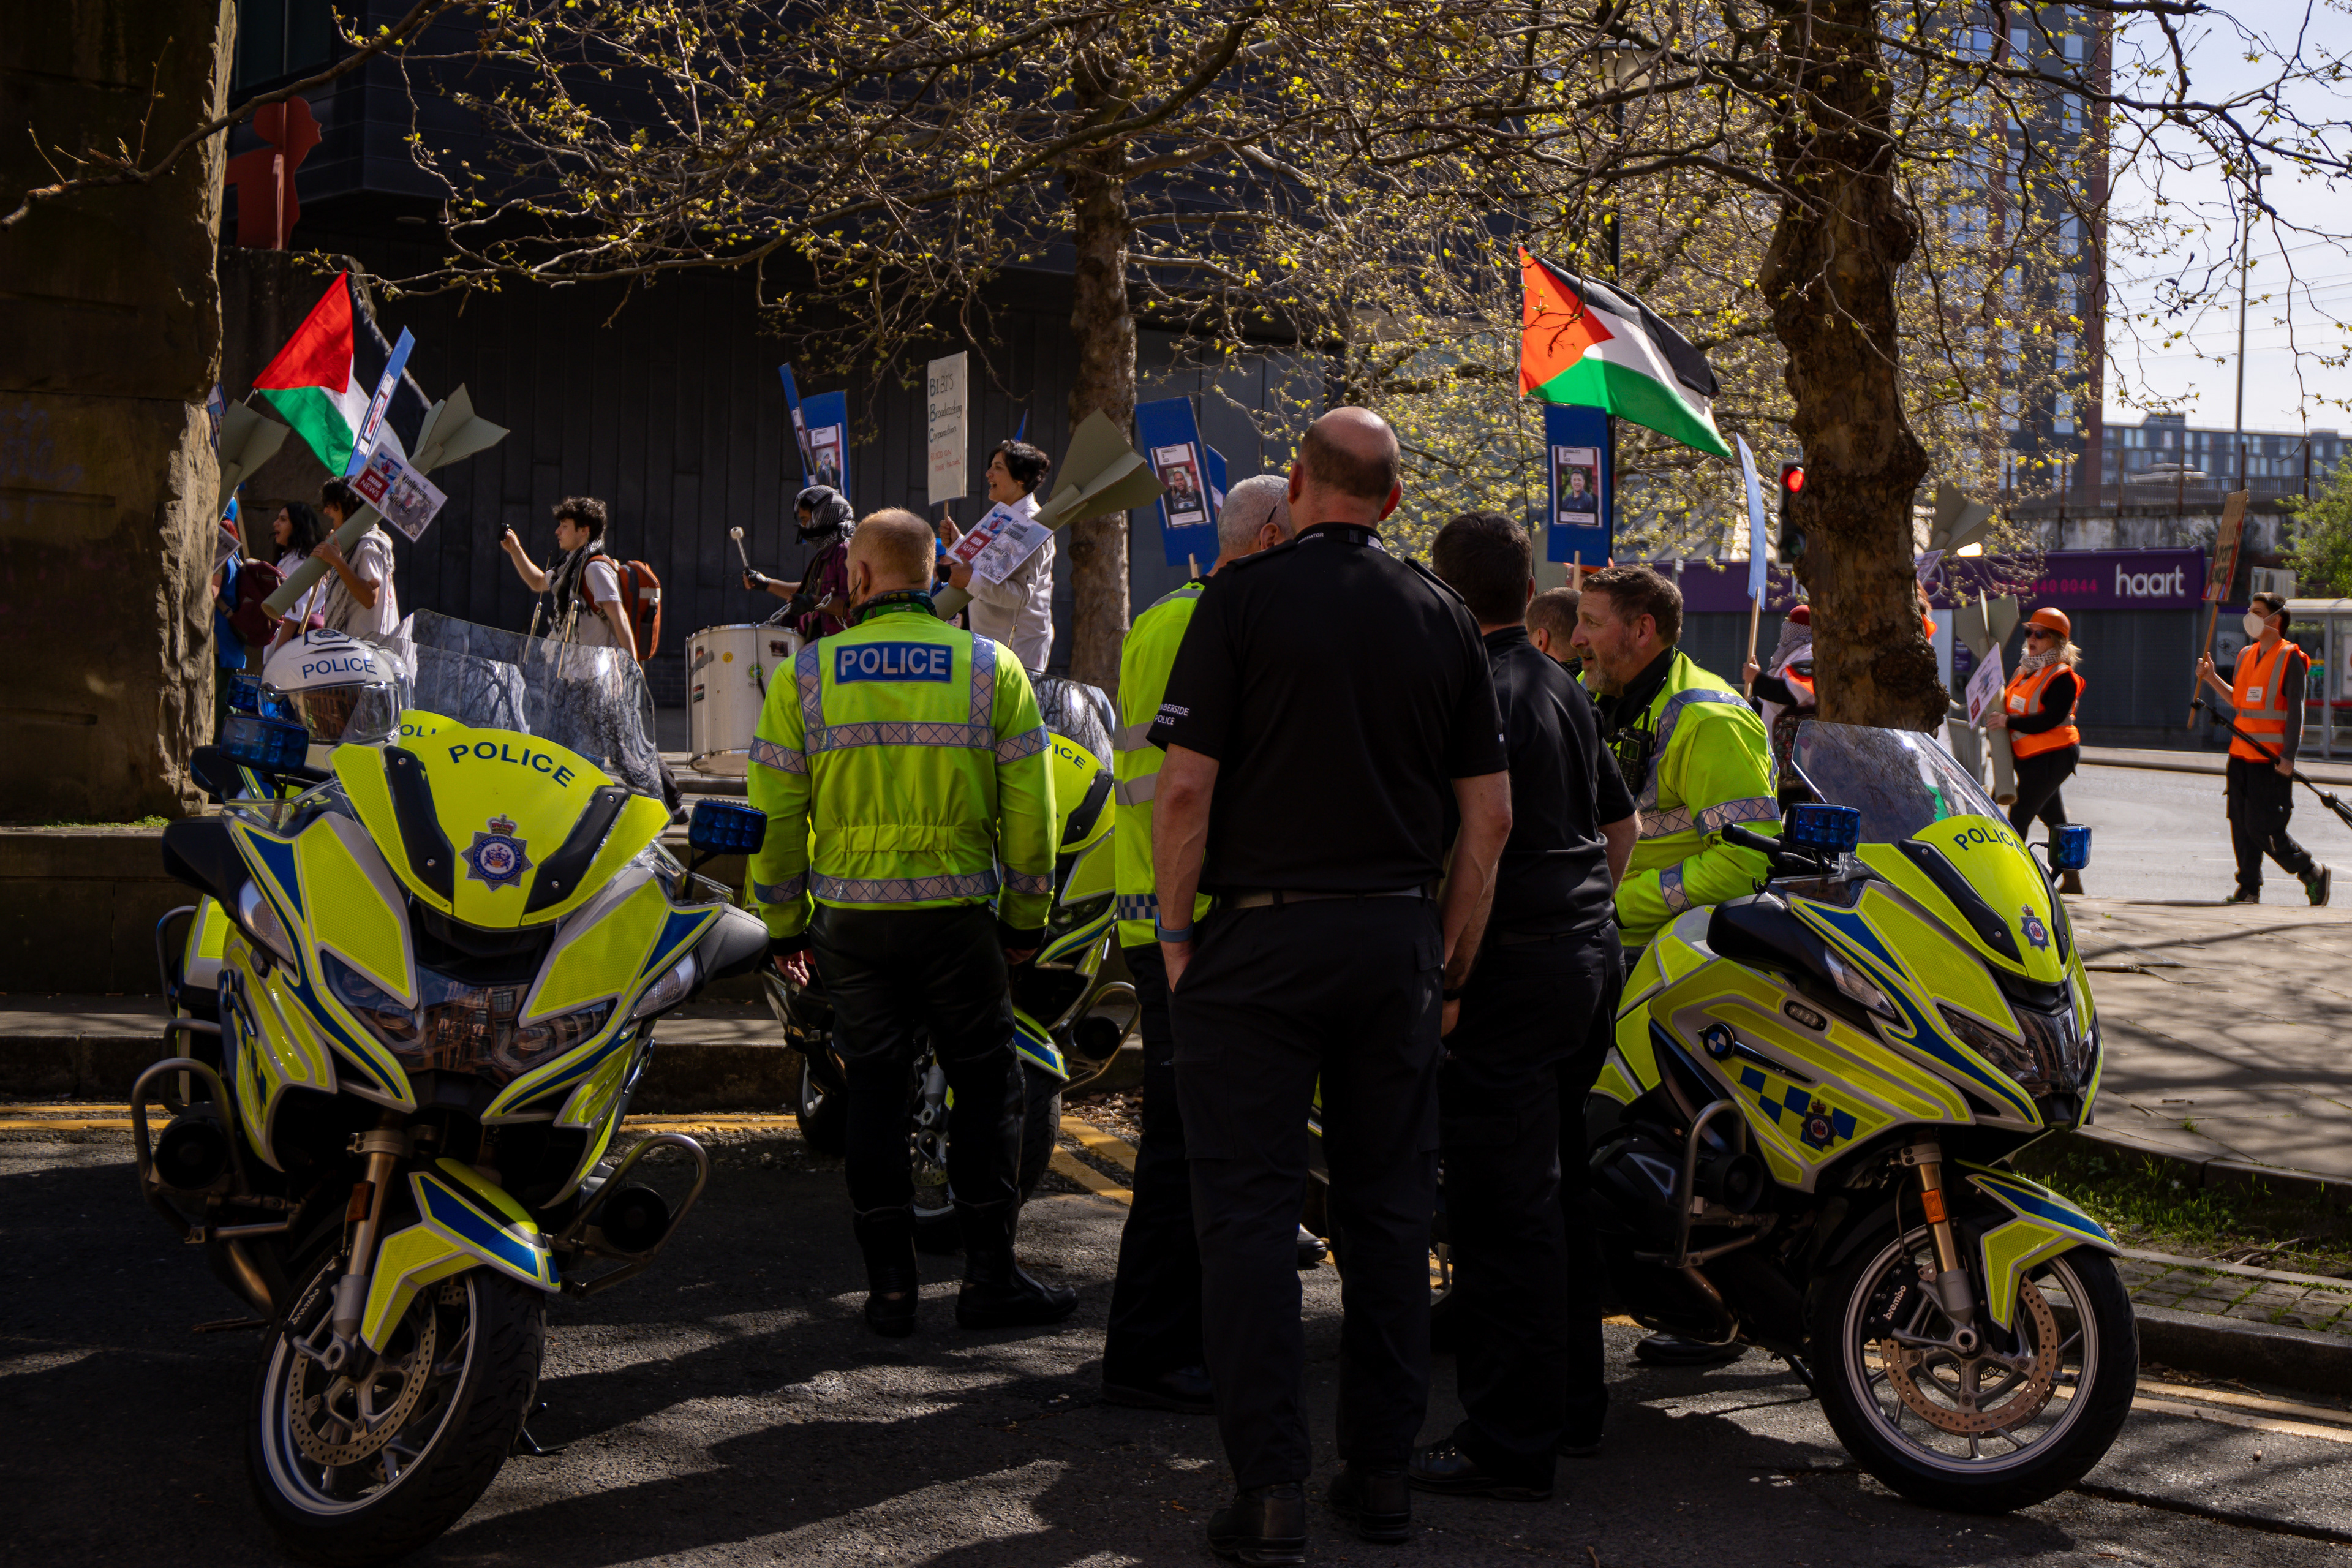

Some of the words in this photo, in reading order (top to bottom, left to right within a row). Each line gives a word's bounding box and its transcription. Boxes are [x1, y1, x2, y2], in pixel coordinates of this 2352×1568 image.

[930, 373, 954, 397] BIBI'S
[930, 399, 962, 423] Broadcasting
[929, 424, 957, 443] Corporation
[360, 479, 381, 497] NEWS
[368, 475, 383, 489] BBC
[960, 542, 979, 554] NEWS
[2060, 579, 2098, 593] 0044
[2115, 562, 2185, 598] haart
[302, 658, 378, 679] POLICE
[840, 647, 946, 676] POLICE
[1154, 714, 1175, 725] POLICE
[448, 741, 576, 788] POLICE
[1054, 744, 1086, 769] ICE
[474, 844, 484, 857] WEST
[483, 837, 514, 846] YORKSHIRE
[512, 846, 521, 863] POLICE
[1953, 827, 2026, 857] POLICE
[291, 1288, 320, 1325] brembo
[1883, 1285, 1907, 1321] brembo
